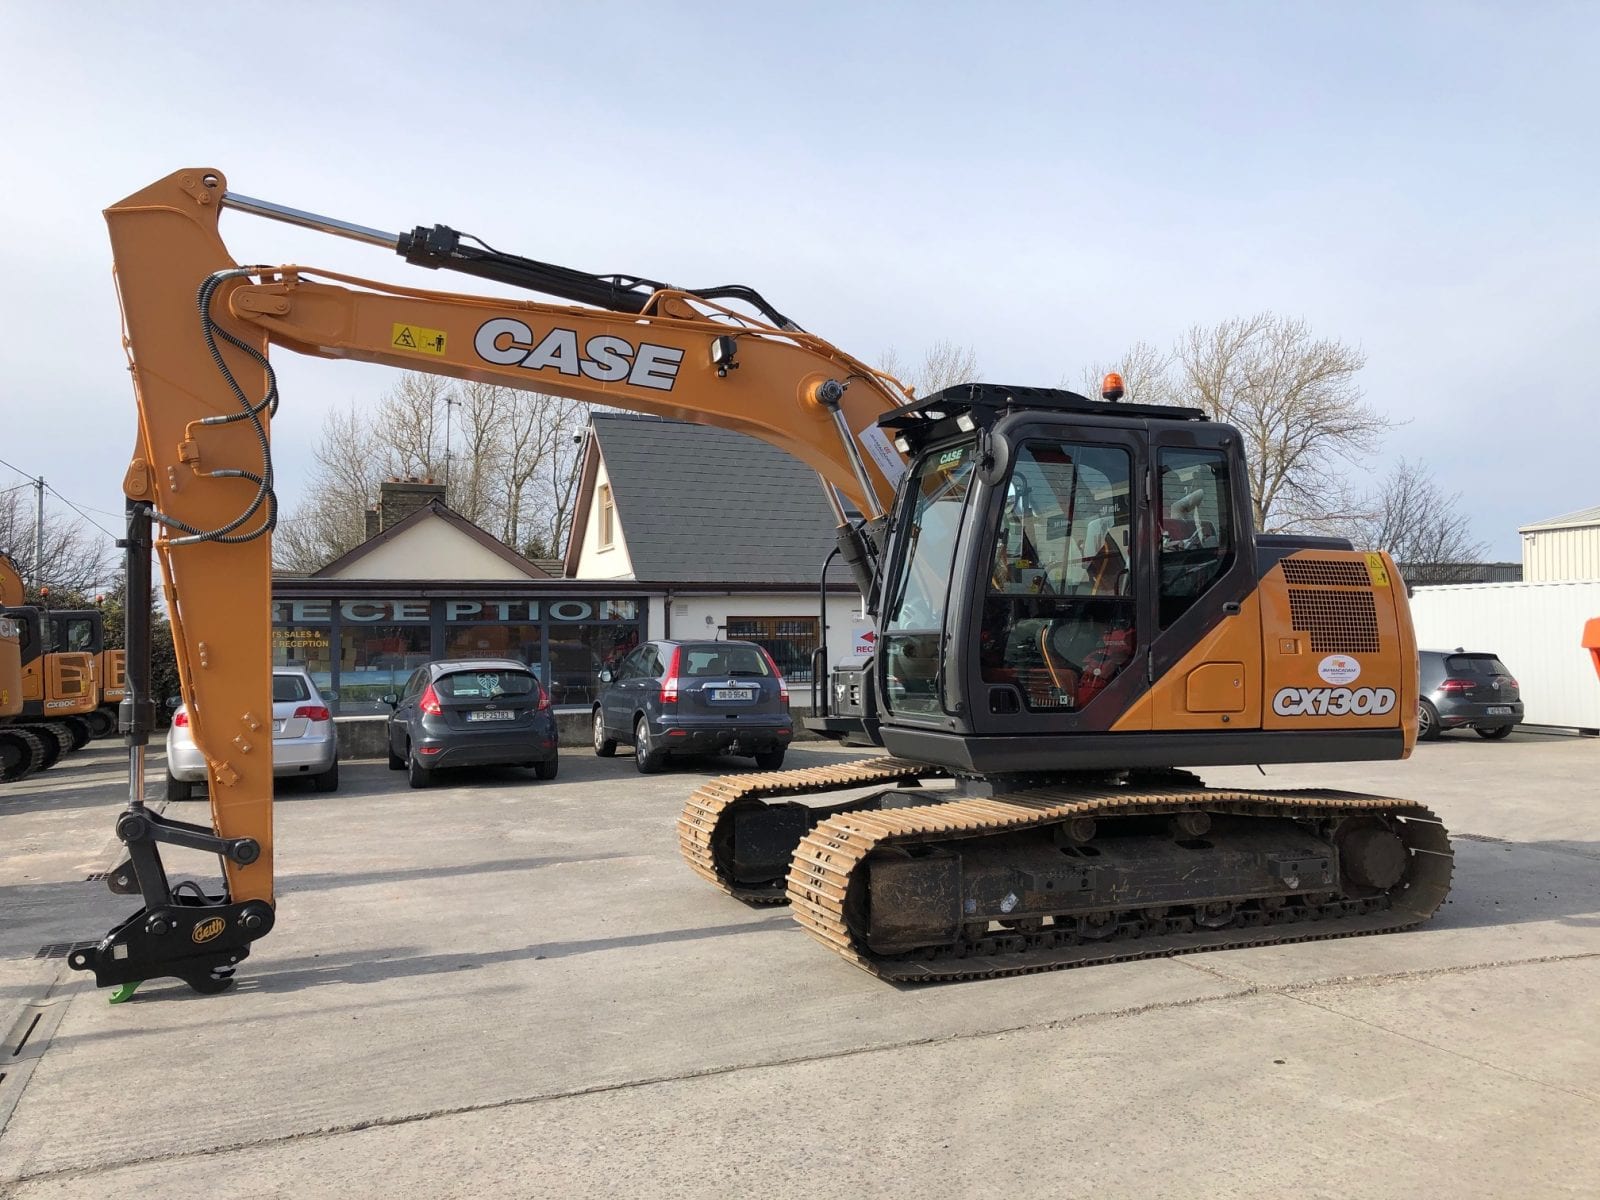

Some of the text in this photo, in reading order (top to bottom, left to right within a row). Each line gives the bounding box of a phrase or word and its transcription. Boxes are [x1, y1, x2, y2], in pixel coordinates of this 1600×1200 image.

[473, 317, 686, 392] CASE
[940, 449, 964, 464] CASE
[279, 640, 329, 648] RECEPTION
[856, 645, 875, 653] REC
[1272, 687, 1397, 716] CX130D
